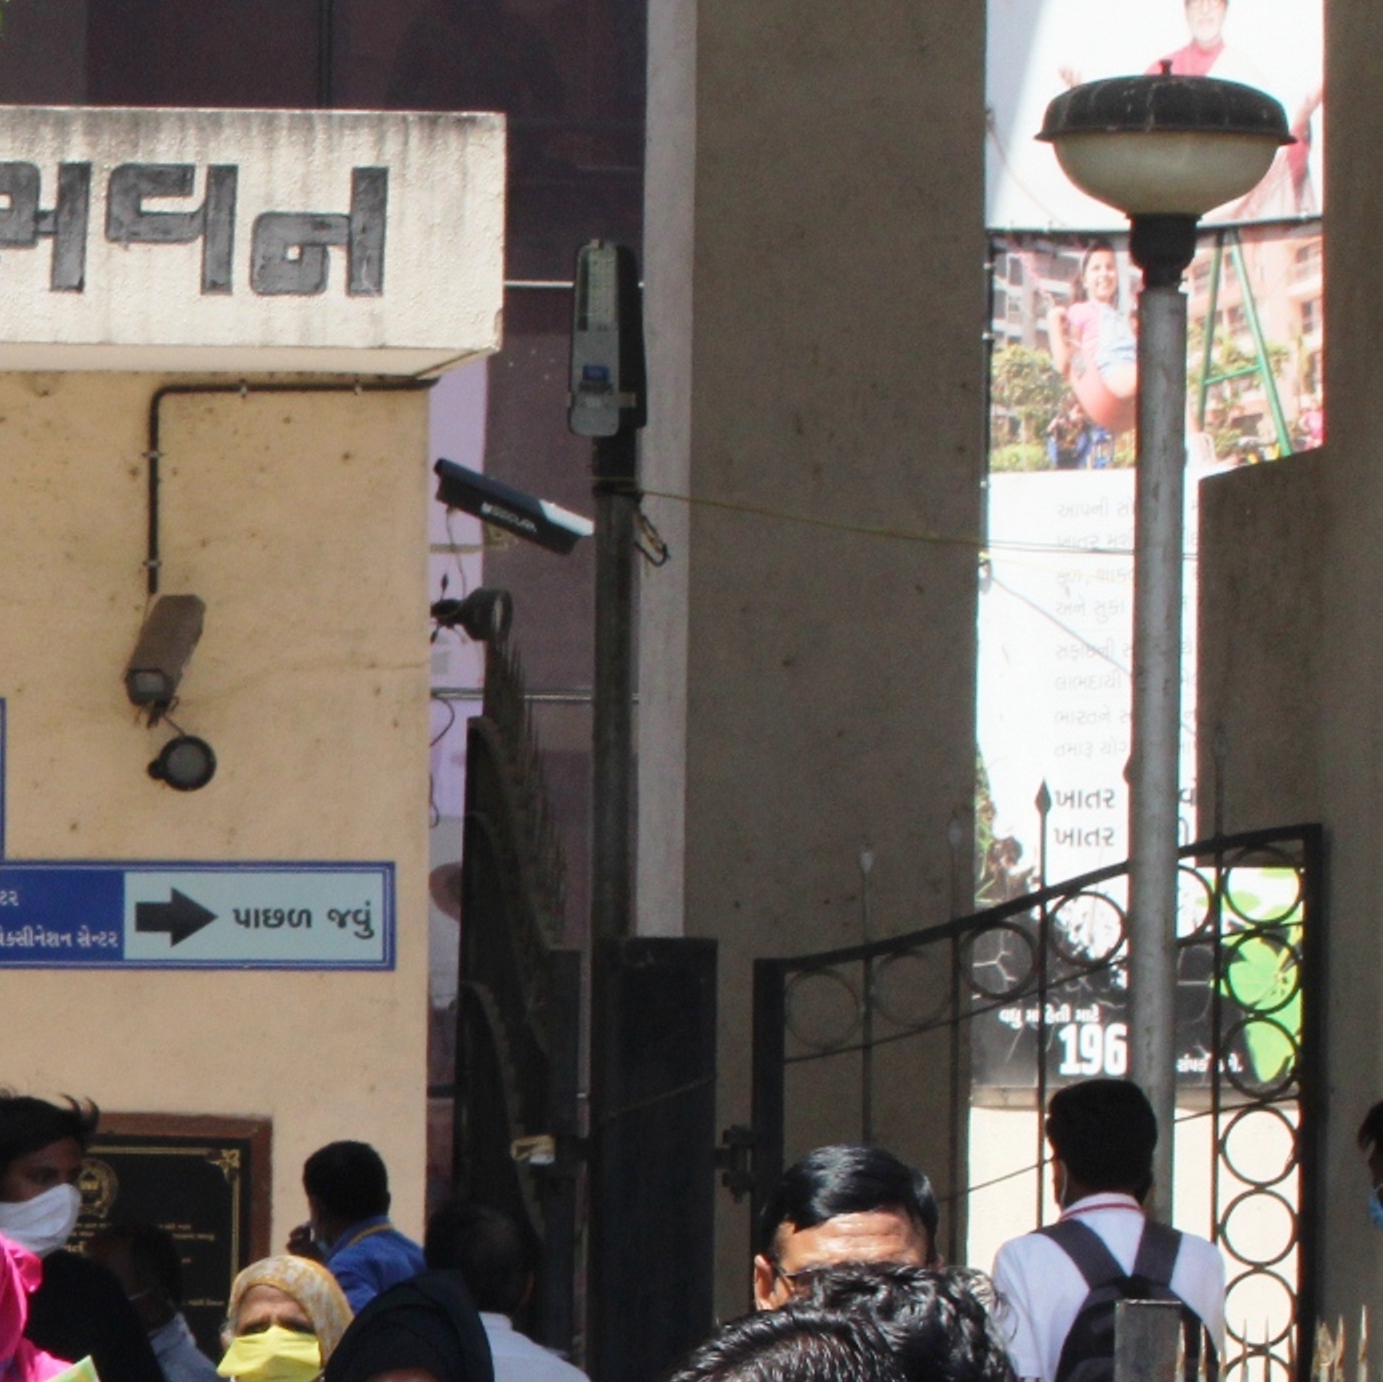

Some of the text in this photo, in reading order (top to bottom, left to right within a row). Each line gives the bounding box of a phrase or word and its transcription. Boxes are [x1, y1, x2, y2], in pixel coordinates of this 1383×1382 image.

[77, 924, 120, 948] સેન્ટર
[232, 900, 376, 940] પાછળ જવું
